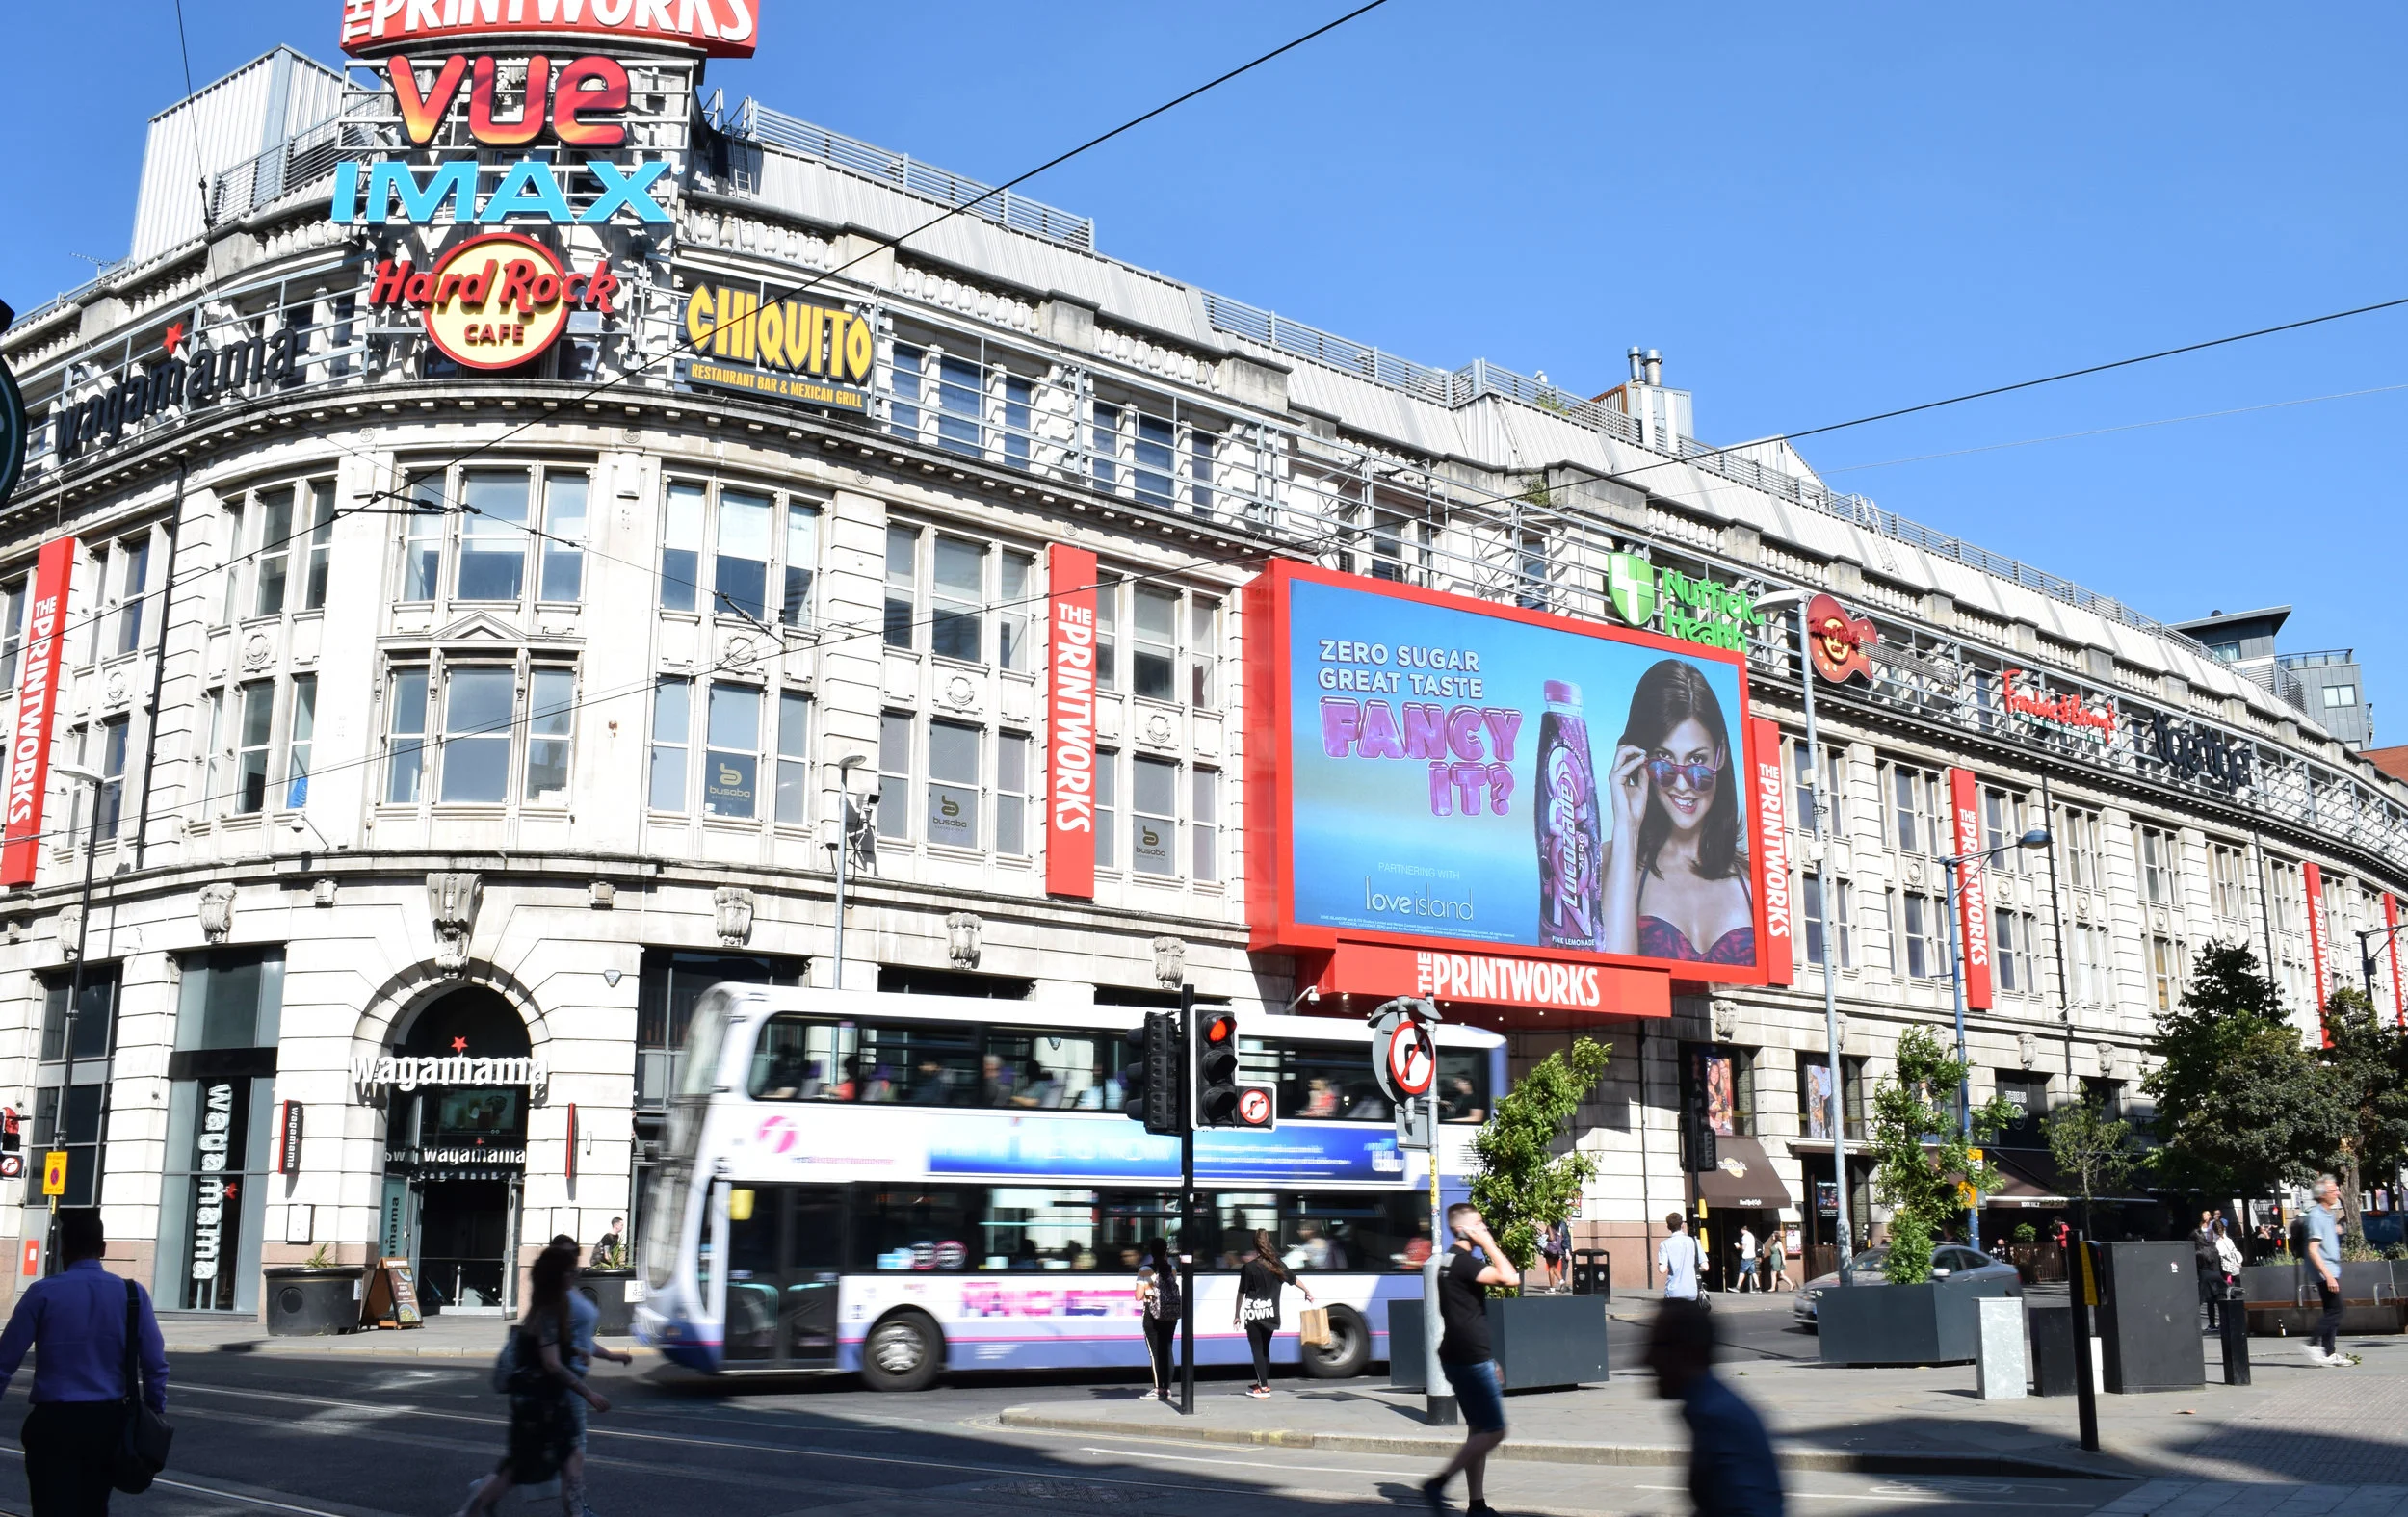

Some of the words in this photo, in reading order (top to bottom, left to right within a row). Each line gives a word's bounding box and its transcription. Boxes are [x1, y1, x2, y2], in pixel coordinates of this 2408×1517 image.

[342, 0, 373, 43] TH
[331, 161, 673, 224] IMAX
[369, 259, 499, 310] Hard
[498, 259, 619, 316] Rock
[464, 324, 525, 346] CAFE
[687, 283, 873, 381] CHIQUITO
[55, 328, 298, 454] wagamama
[691, 363, 755, 388] RESTAURANT
[757, 376, 777, 393] BAR
[779, 380, 788, 393] &
[790, 381, 833, 403] MEXICAN
[835, 390, 863, 408] GRILL
[36, 595, 57, 619] THE
[1058, 602, 1092, 626] THE
[1664, 603, 1747, 654] Health
[1319, 640, 1389, 665] ZERO
[1397, 645, 1479, 672] SUGAR
[1319, 667, 1401, 693] GREAT
[1409, 673, 1483, 699] TASTE
[9, 612, 54, 825] PRINTWORKS
[1056, 621, 1092, 834] PRINTWORKS
[1320, 695, 1523, 762] FANCY
[709, 785, 751, 798] busaba
[1428, 761, 1516, 817] IT?
[1760, 762, 1779, 779] THE
[932, 815, 967, 829] busaba
[1959, 808, 1976, 824] THE
[1136, 845, 1166, 858] busaba
[1378, 861, 1435, 878] PARTNERING
[1437, 867, 1460, 880] WITH
[1578, 833, 1586, 871] ZERO
[1760, 778, 1790, 937] PRINTWORKS
[1364, 876, 1411, 915] love
[1414, 881, 1474, 922] island
[1960, 821, 1987, 966] PRINTWORKS
[1552, 934, 1564, 945] PINK
[1565, 937, 1595, 947] LEMONADE
[2314, 904, 2333, 1015] PRINTWOR
[1417, 952, 1433, 993] THE
[1433, 953, 1600, 1007] PRINTWORKS
[351, 1056, 548, 1091] wagamama
[287, 1106, 299, 1169] wagamama
[424, 1146, 526, 1164] wagamama
[192, 1083, 233, 1280] wagamama
